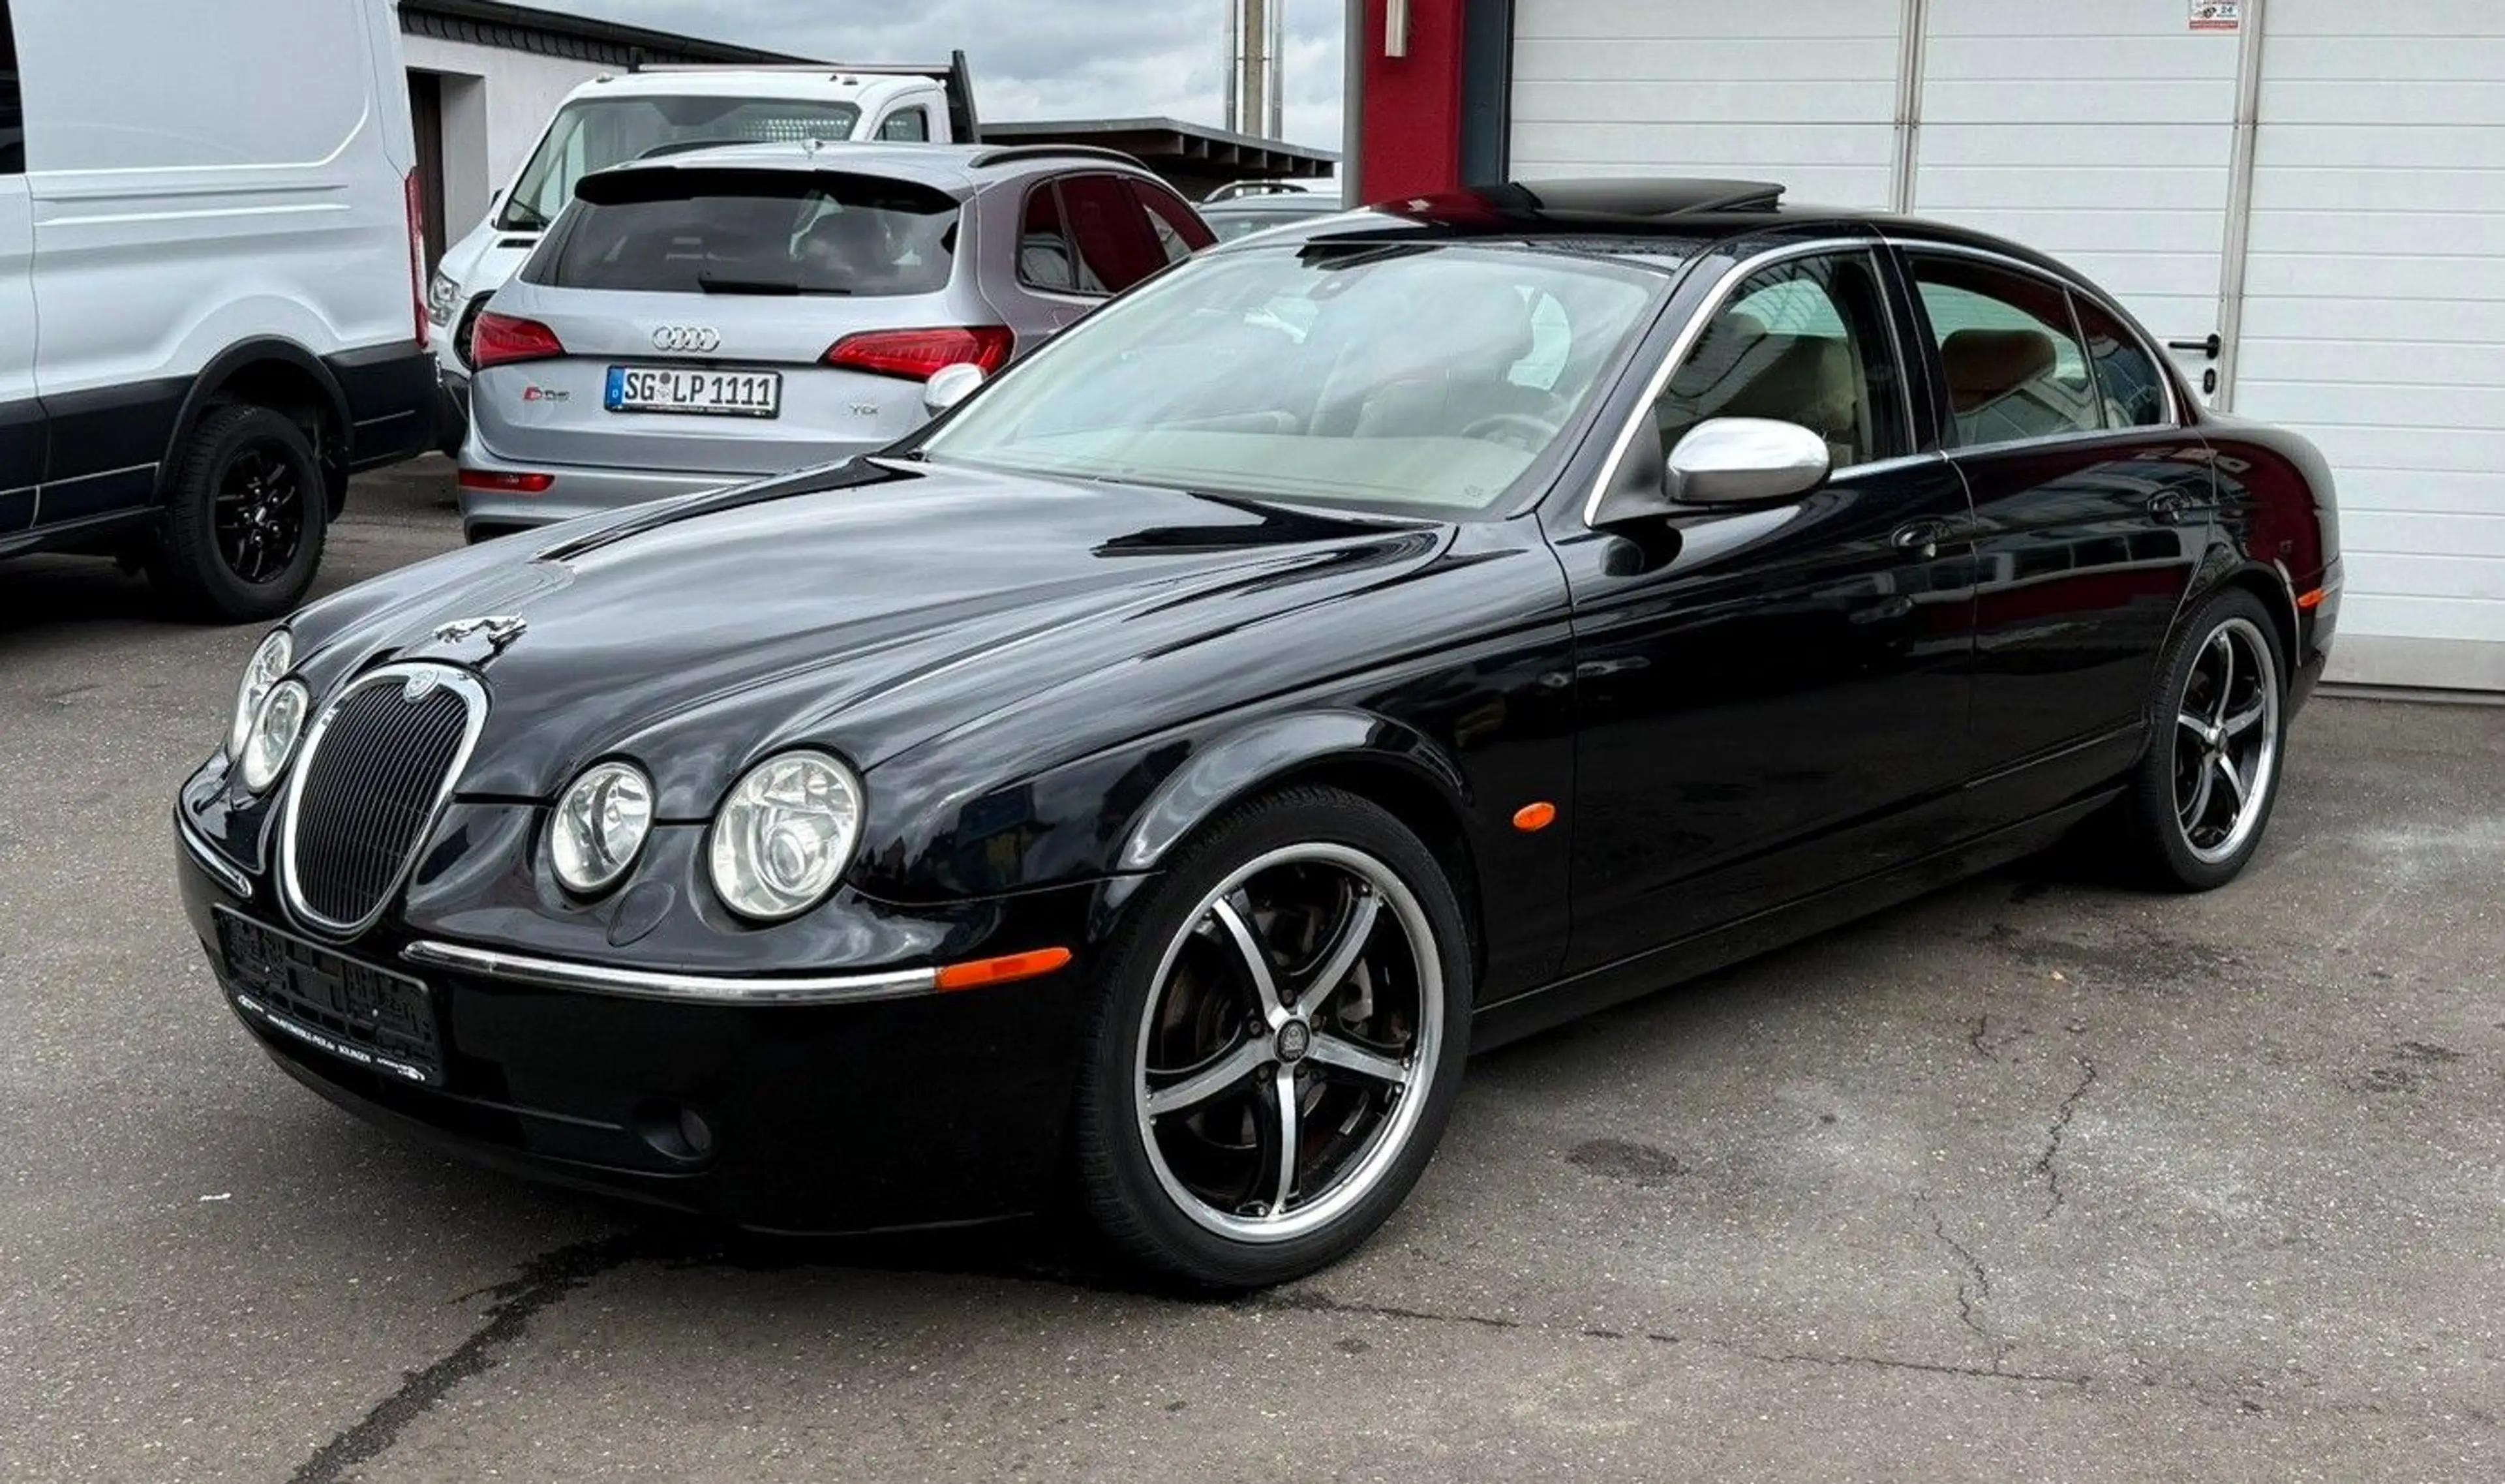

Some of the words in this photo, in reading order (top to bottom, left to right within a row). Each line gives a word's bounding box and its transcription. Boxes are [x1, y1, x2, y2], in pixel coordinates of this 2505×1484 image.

[624, 372, 656, 401] SG
[673, 374, 705, 403] LP
[709, 376, 771, 406] 1111
